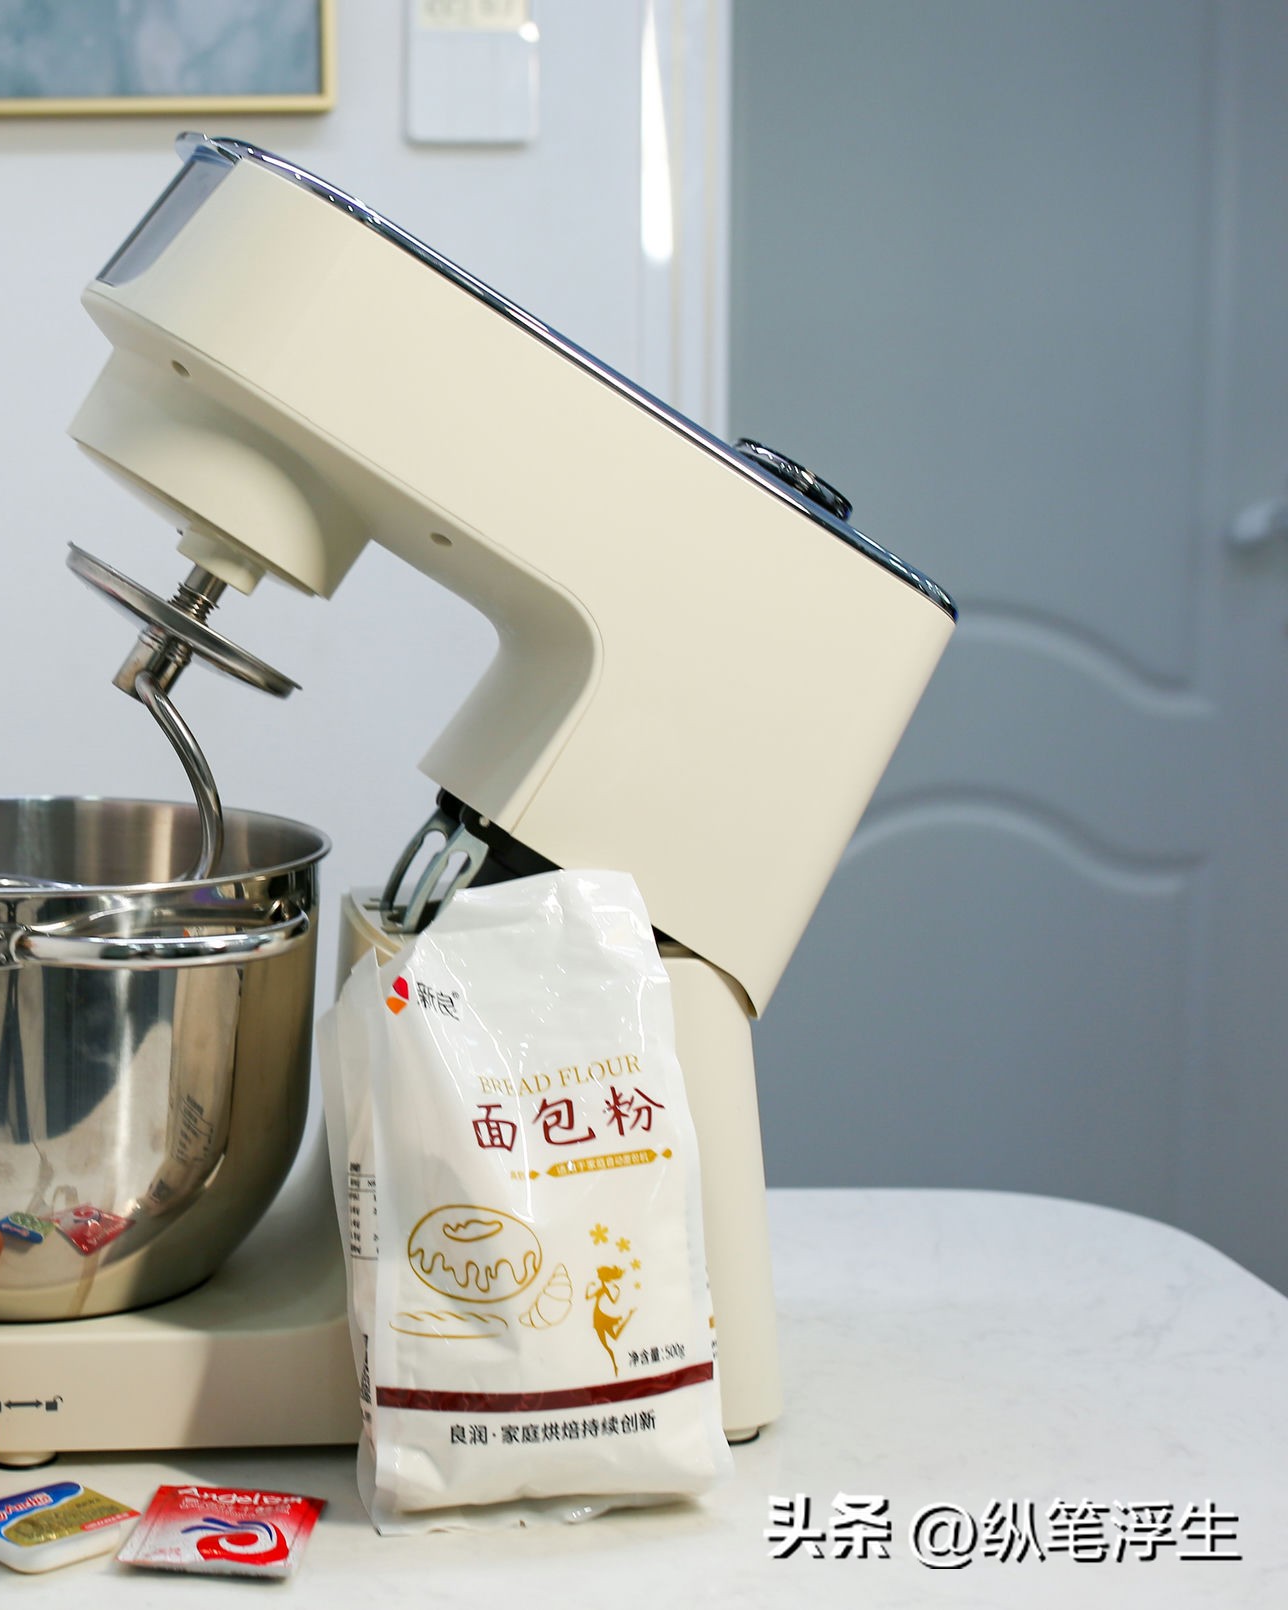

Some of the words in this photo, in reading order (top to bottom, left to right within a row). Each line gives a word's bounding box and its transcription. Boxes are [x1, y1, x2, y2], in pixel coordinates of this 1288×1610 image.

[416, 981, 459, 1021] 新良
[480, 1075, 552, 1096] BREAD
[558, 1055, 642, 1087] FLOUR
[472, 1086, 665, 1152] 面包粉
